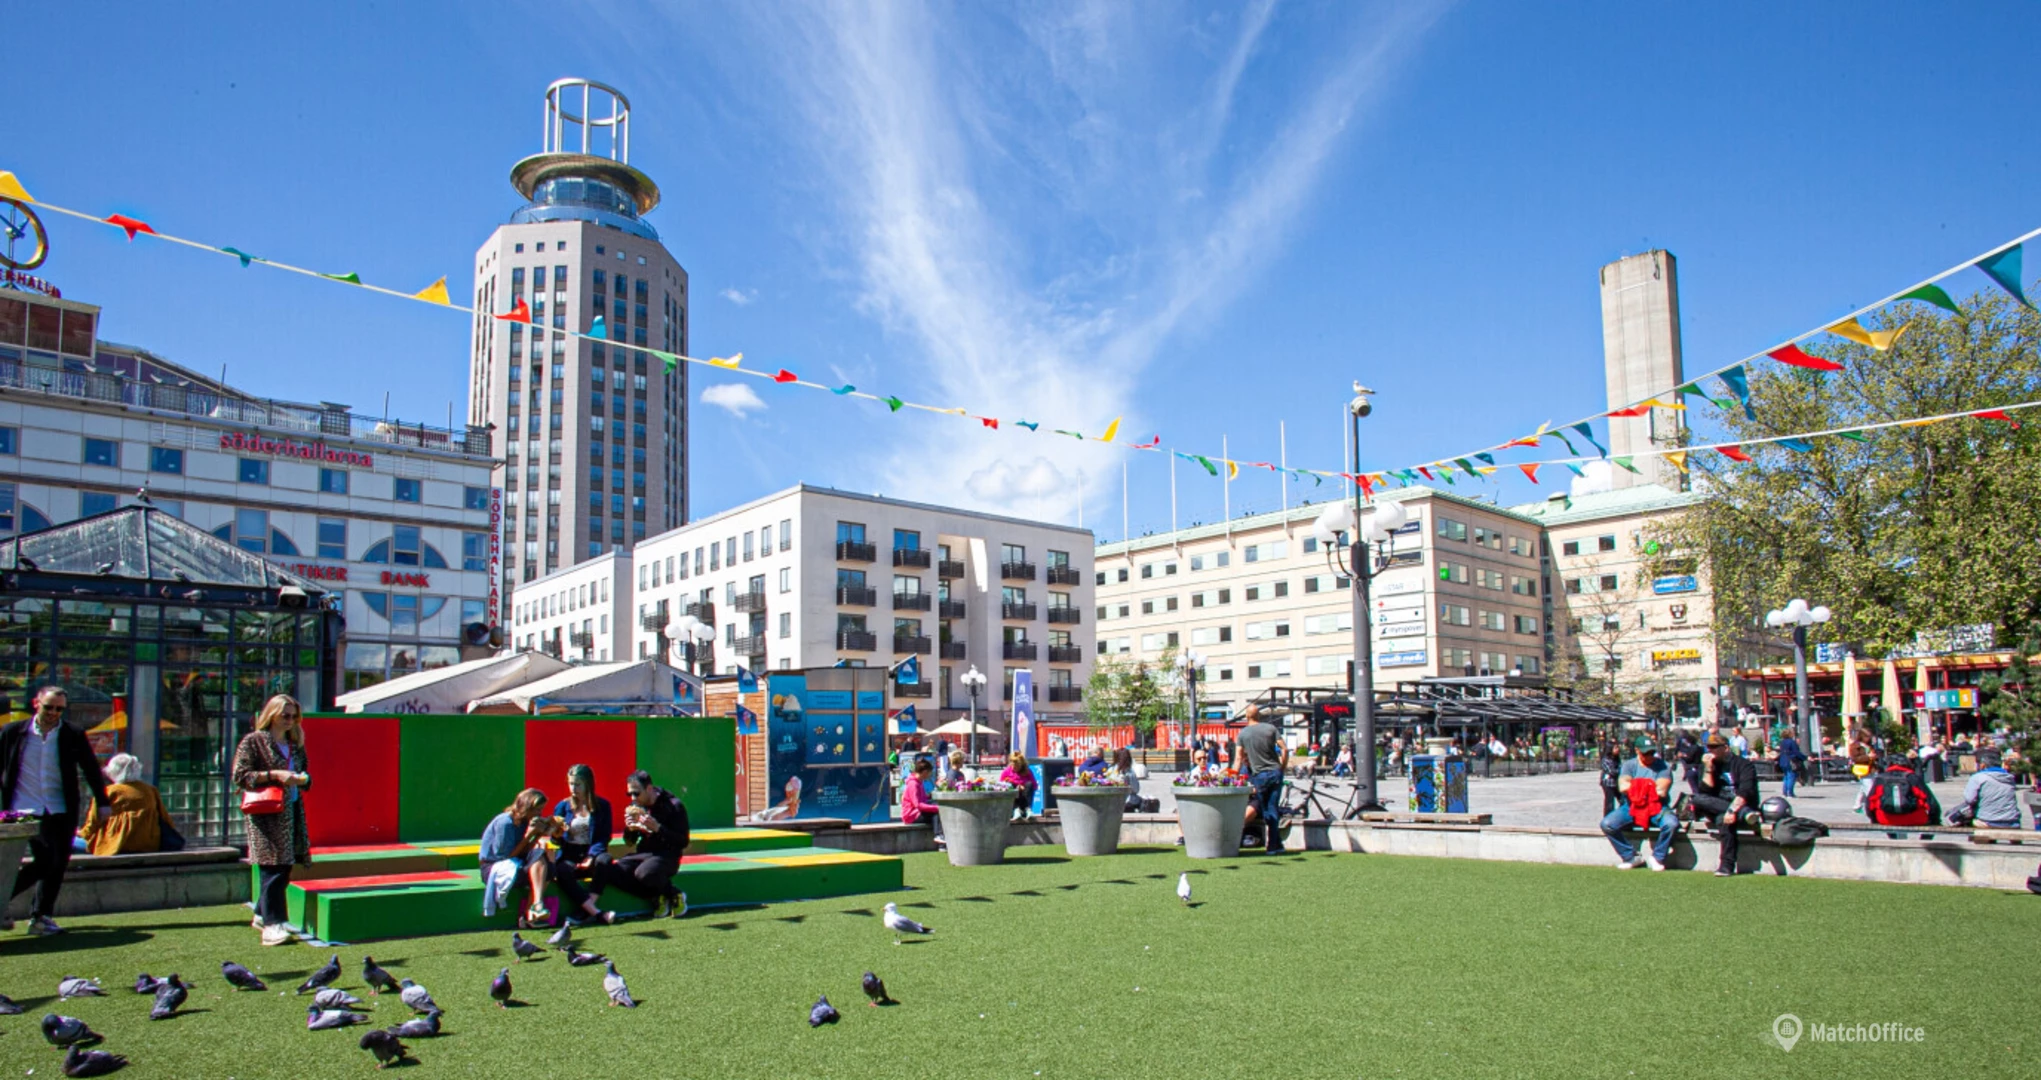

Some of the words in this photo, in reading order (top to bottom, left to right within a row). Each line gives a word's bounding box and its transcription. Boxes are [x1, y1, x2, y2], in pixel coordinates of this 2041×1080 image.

[219, 432, 373, 467] söderhallarna
[489, 489, 500, 628] SÖDERHALLARNA
[380, 571, 430, 588] BANK
